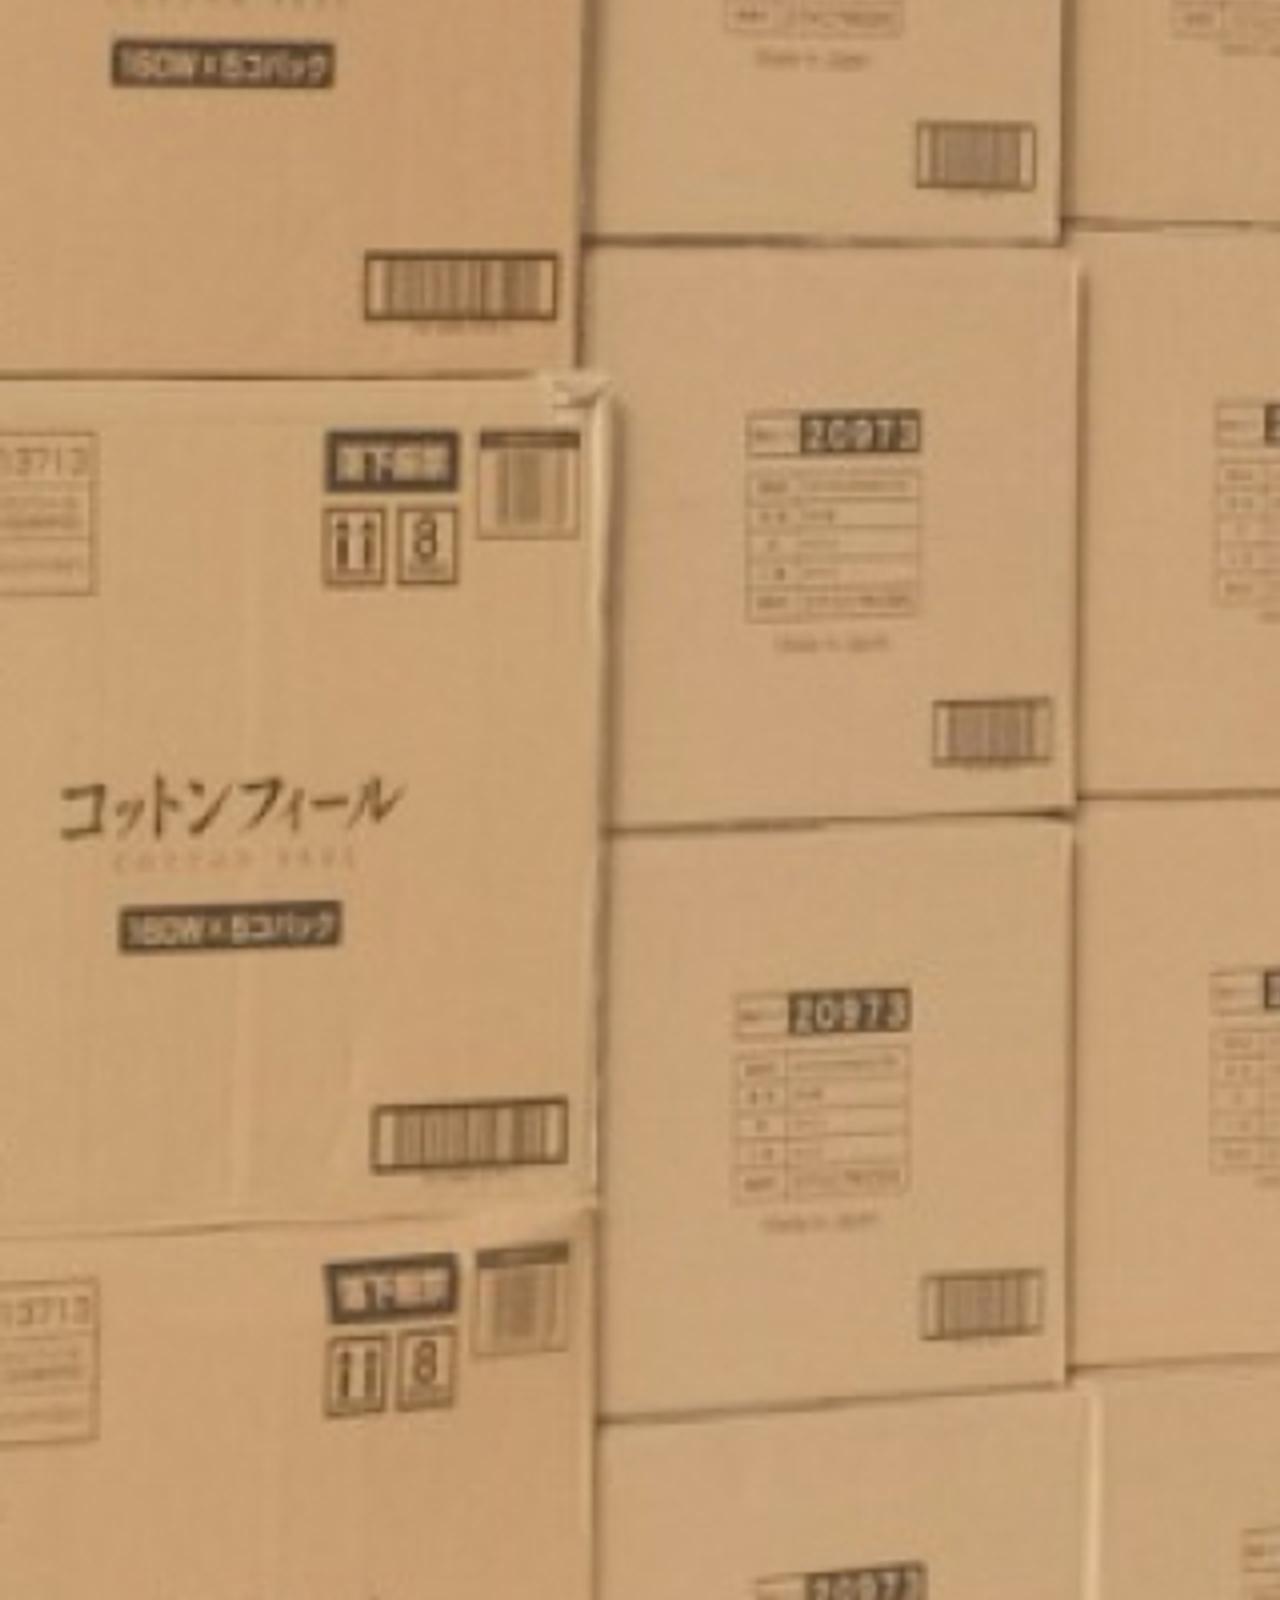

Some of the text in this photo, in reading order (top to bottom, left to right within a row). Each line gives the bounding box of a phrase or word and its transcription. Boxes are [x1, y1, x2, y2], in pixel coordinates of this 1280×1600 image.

[804, 415, 917, 451] 20973
[60, 773, 406, 840] コットンフィール
[792, 995, 908, 1033] 20973
